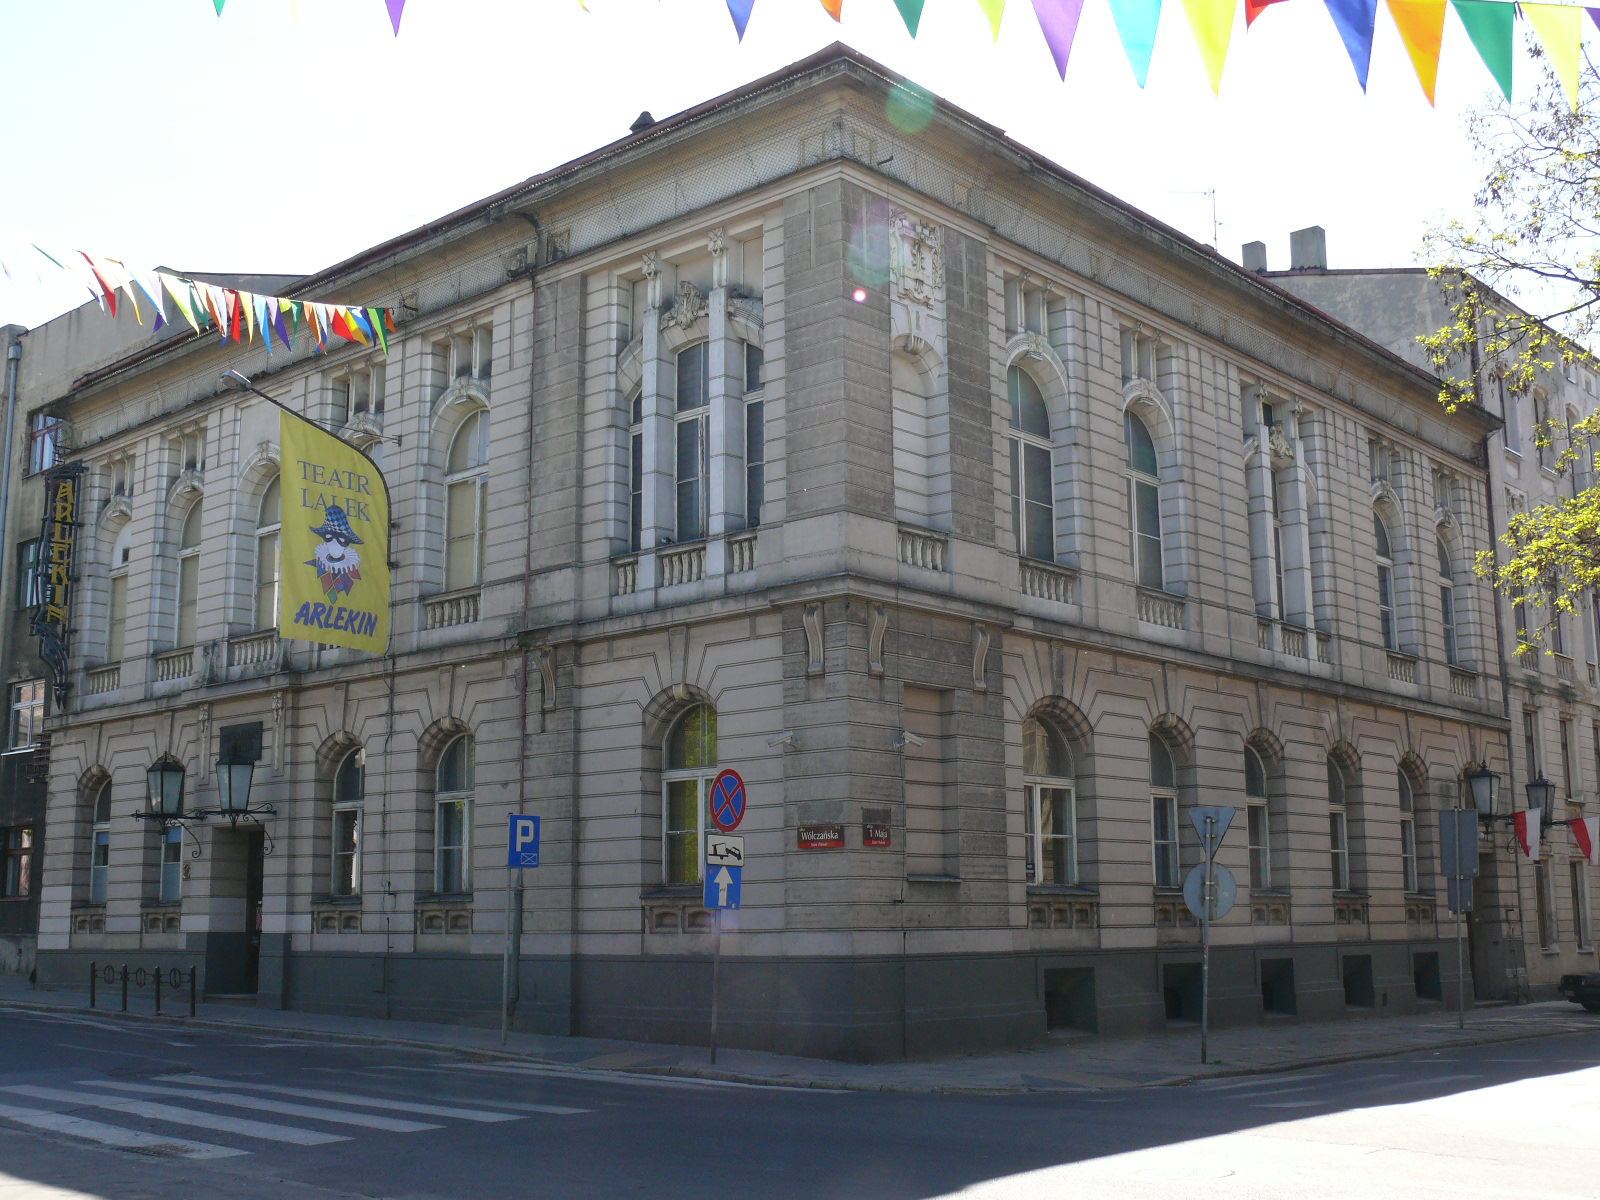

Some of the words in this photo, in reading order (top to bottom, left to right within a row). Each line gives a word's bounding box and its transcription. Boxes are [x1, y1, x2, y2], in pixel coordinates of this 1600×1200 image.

[297, 461, 373, 496] TEATR
[47, 480, 74, 623] ARLEKIN
[294, 601, 378, 638] ARLEKIN
[516, 819, 534, 852] P
[801, 829, 839, 841] Wólczańska
[874, 829, 888, 840] Maja
